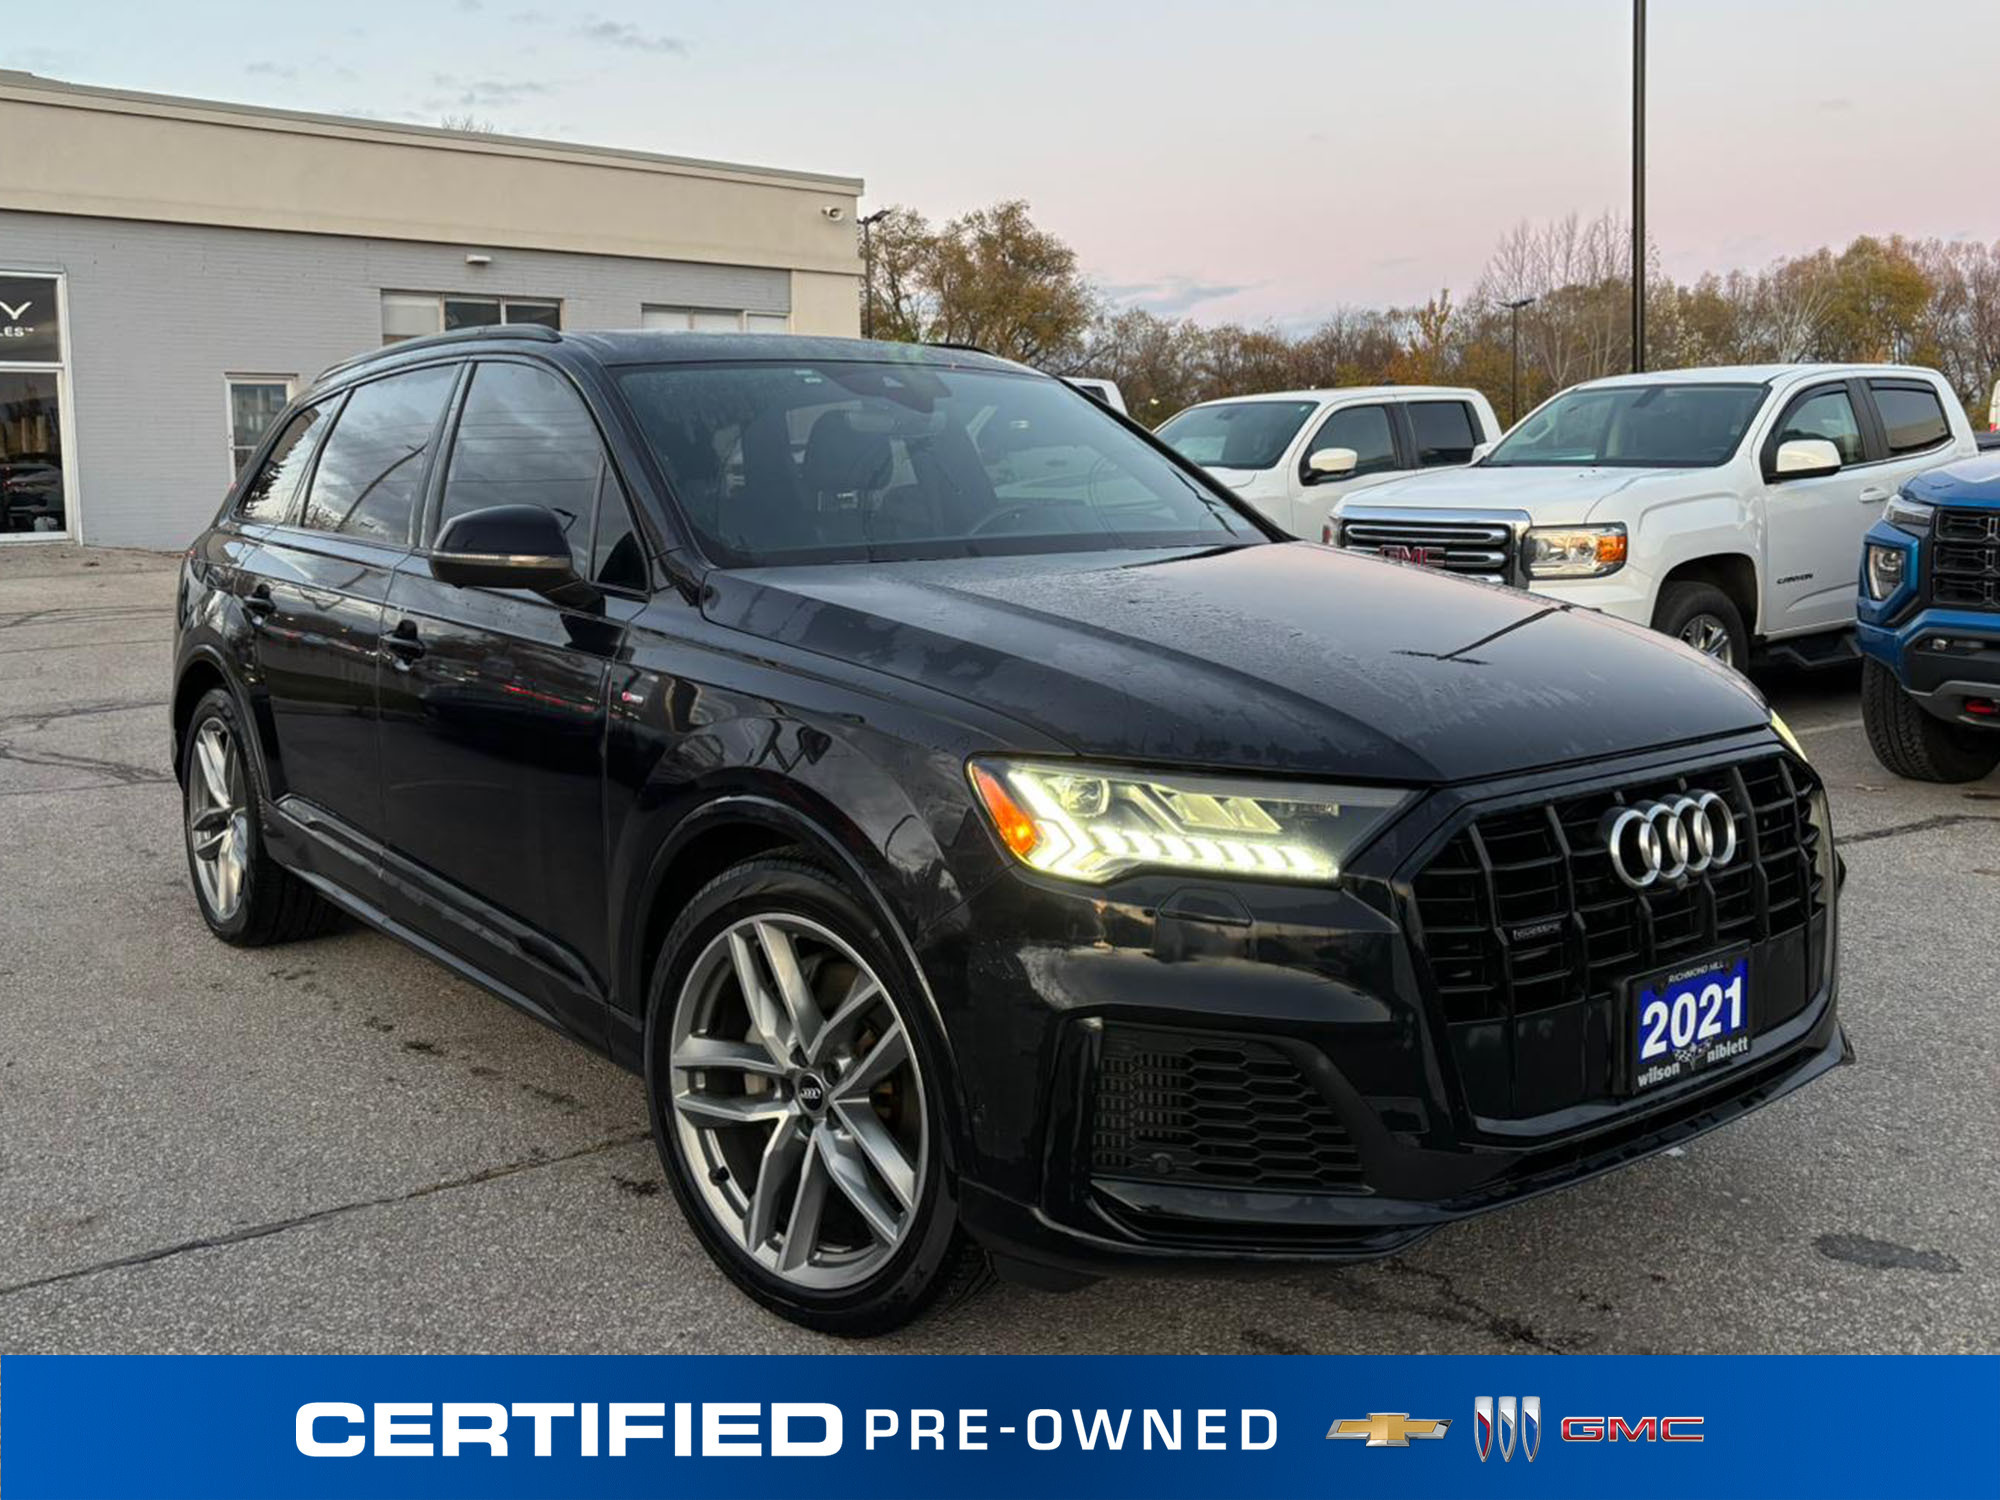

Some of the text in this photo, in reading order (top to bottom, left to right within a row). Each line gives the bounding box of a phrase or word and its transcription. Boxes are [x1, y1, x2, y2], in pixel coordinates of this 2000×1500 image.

[1668, 965, 1709, 983] RICHMOND
[1641, 976, 1742, 1060] 2021
[1637, 1036, 1748, 1087] wilson niblett
